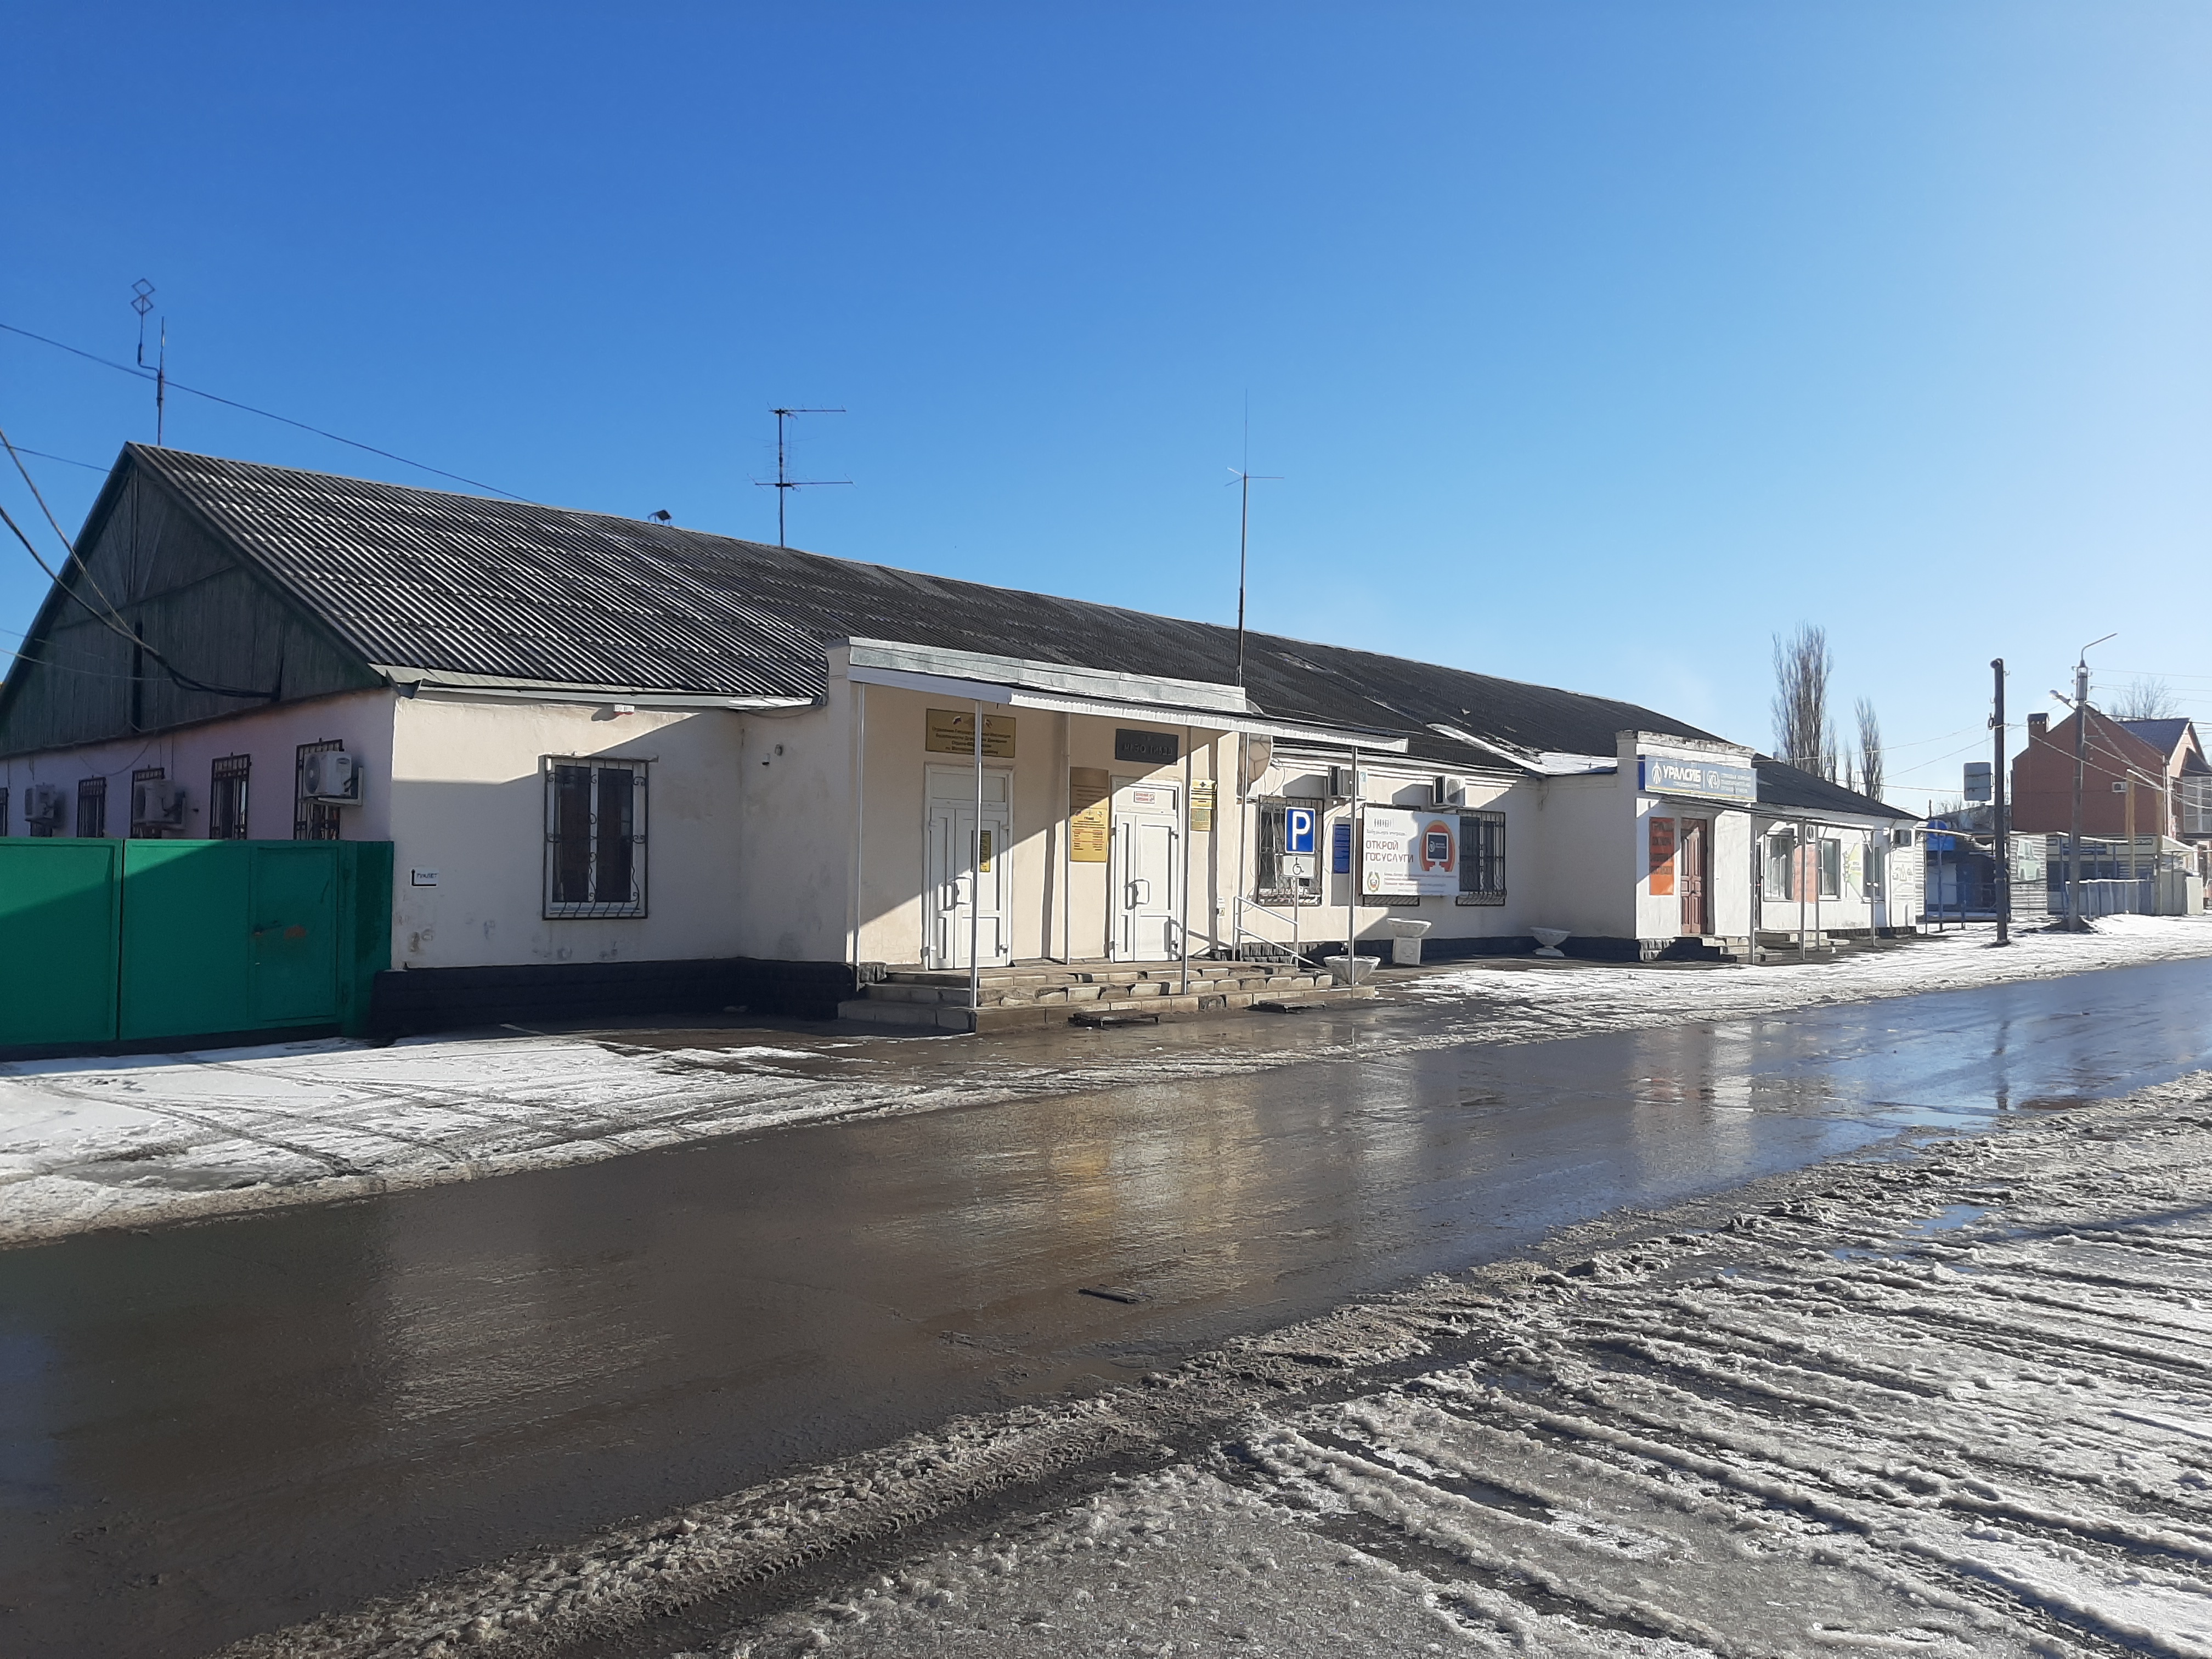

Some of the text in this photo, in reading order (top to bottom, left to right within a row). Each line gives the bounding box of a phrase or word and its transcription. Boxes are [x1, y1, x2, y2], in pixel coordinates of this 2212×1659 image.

[1663, 765, 1701, 782] УРАЛСИБ
[1292, 811, 1310, 850] P
[1365, 839, 1399, 850] ОТКРОЙ
[1365, 851, 1414, 863] ГОСУСЛУГИ
